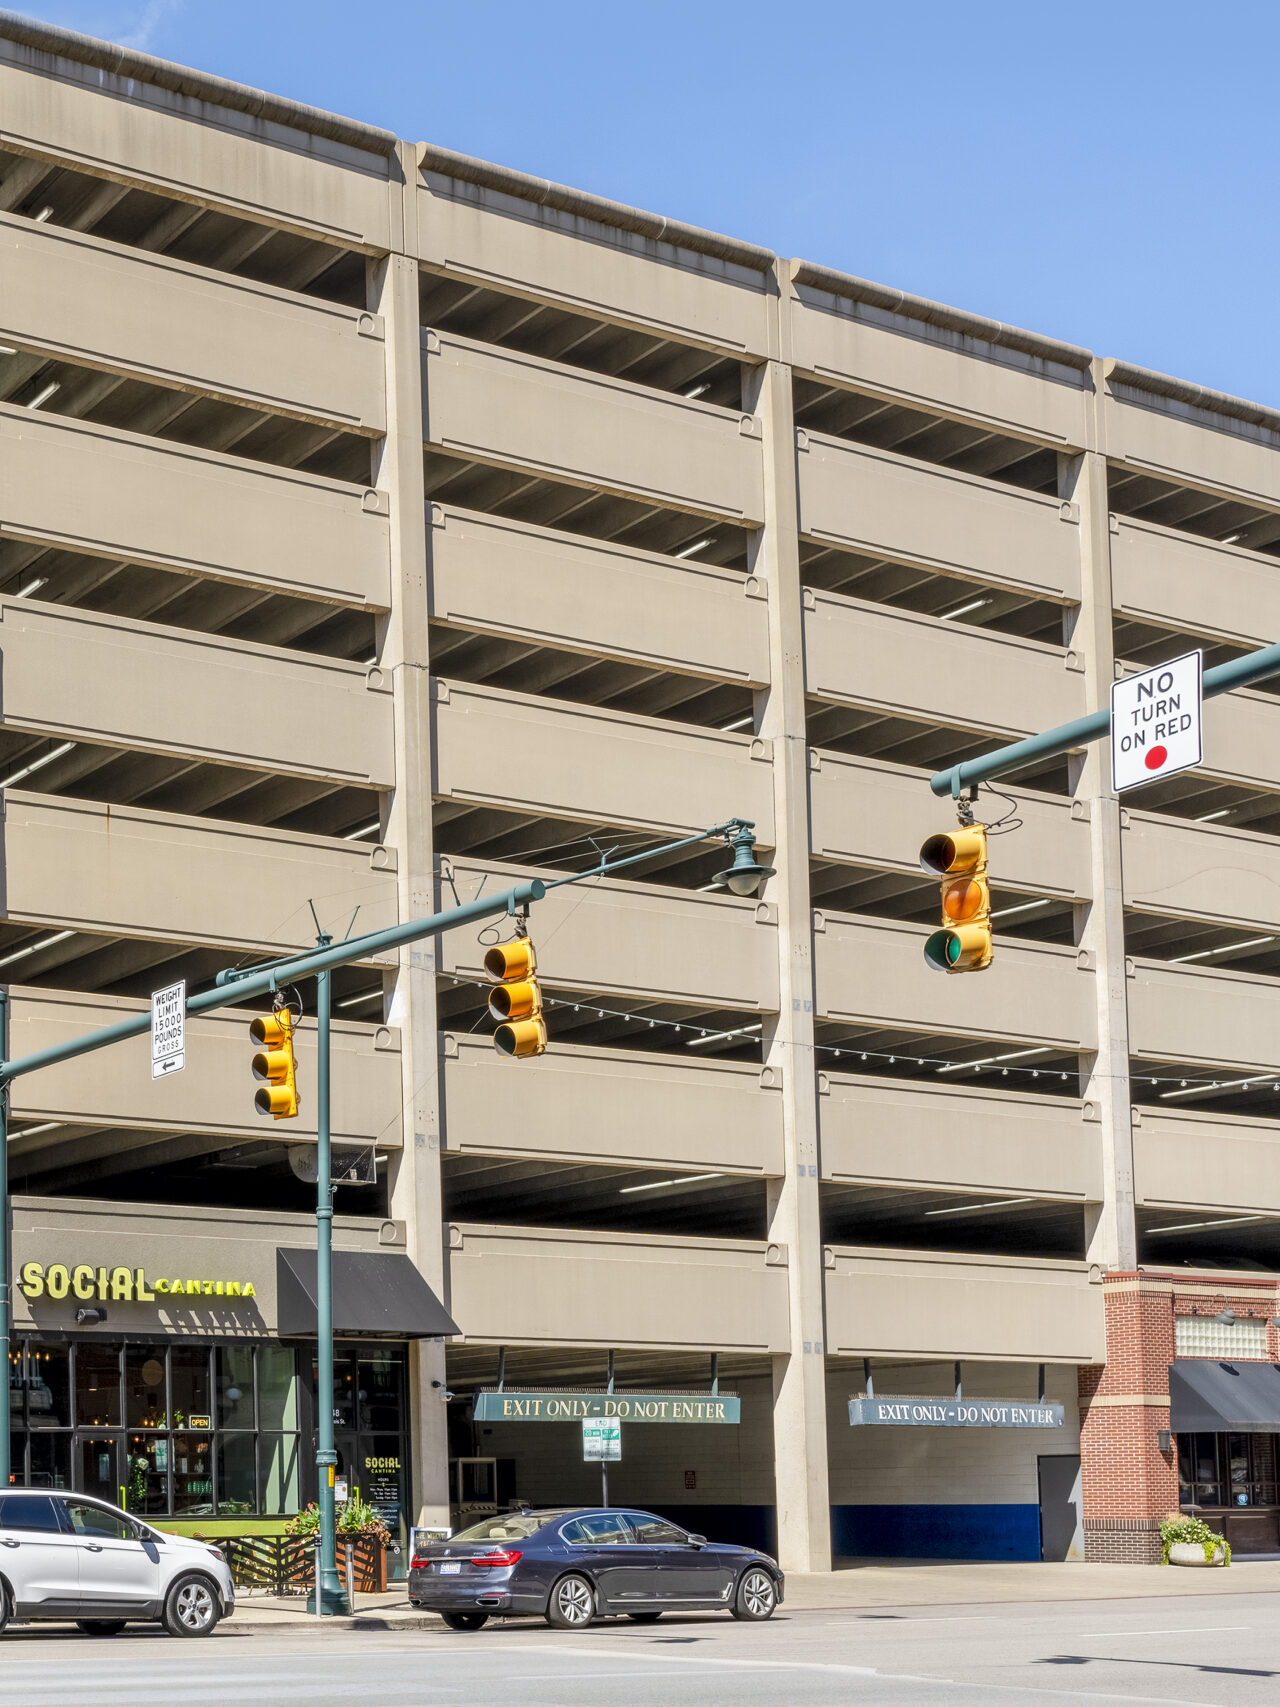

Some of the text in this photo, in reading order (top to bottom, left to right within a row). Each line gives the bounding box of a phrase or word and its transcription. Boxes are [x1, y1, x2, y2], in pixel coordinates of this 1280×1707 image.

[1137, 671, 1174, 703] NO
[1131, 693, 1181, 726] TURN
[1121, 713, 1192, 752] ON RED
[155, 987, 181, 1006] WEIGHT
[158, 1001, 178, 1018] LIMIT
[155, 1013, 182, 1032] 15000
[154, 1025, 182, 1045] POUNDS
[157, 1039, 179, 1054] GROSS
[20, 1261, 257, 1302] SOCIAL CANTINA
[502, 1399, 543, 1417] EXIT
[546, 1400, 592, 1418] ONLY
[604, 1400, 631, 1418] DO
[633, 1401, 669, 1419] NOT
[672, 1402, 726, 1419] ENTER
[878, 1404, 910, 1420] EXIT
[912, 1406, 948, 1421] ONLY
[957, 1407, 978, 1422] DO
[981, 1408, 1009, 1422] NOT
[1011, 1408, 1054, 1424] ENTER
[191, 1419, 209, 1427] OPEN
[365, 1457, 401, 1468] SOCIAL
